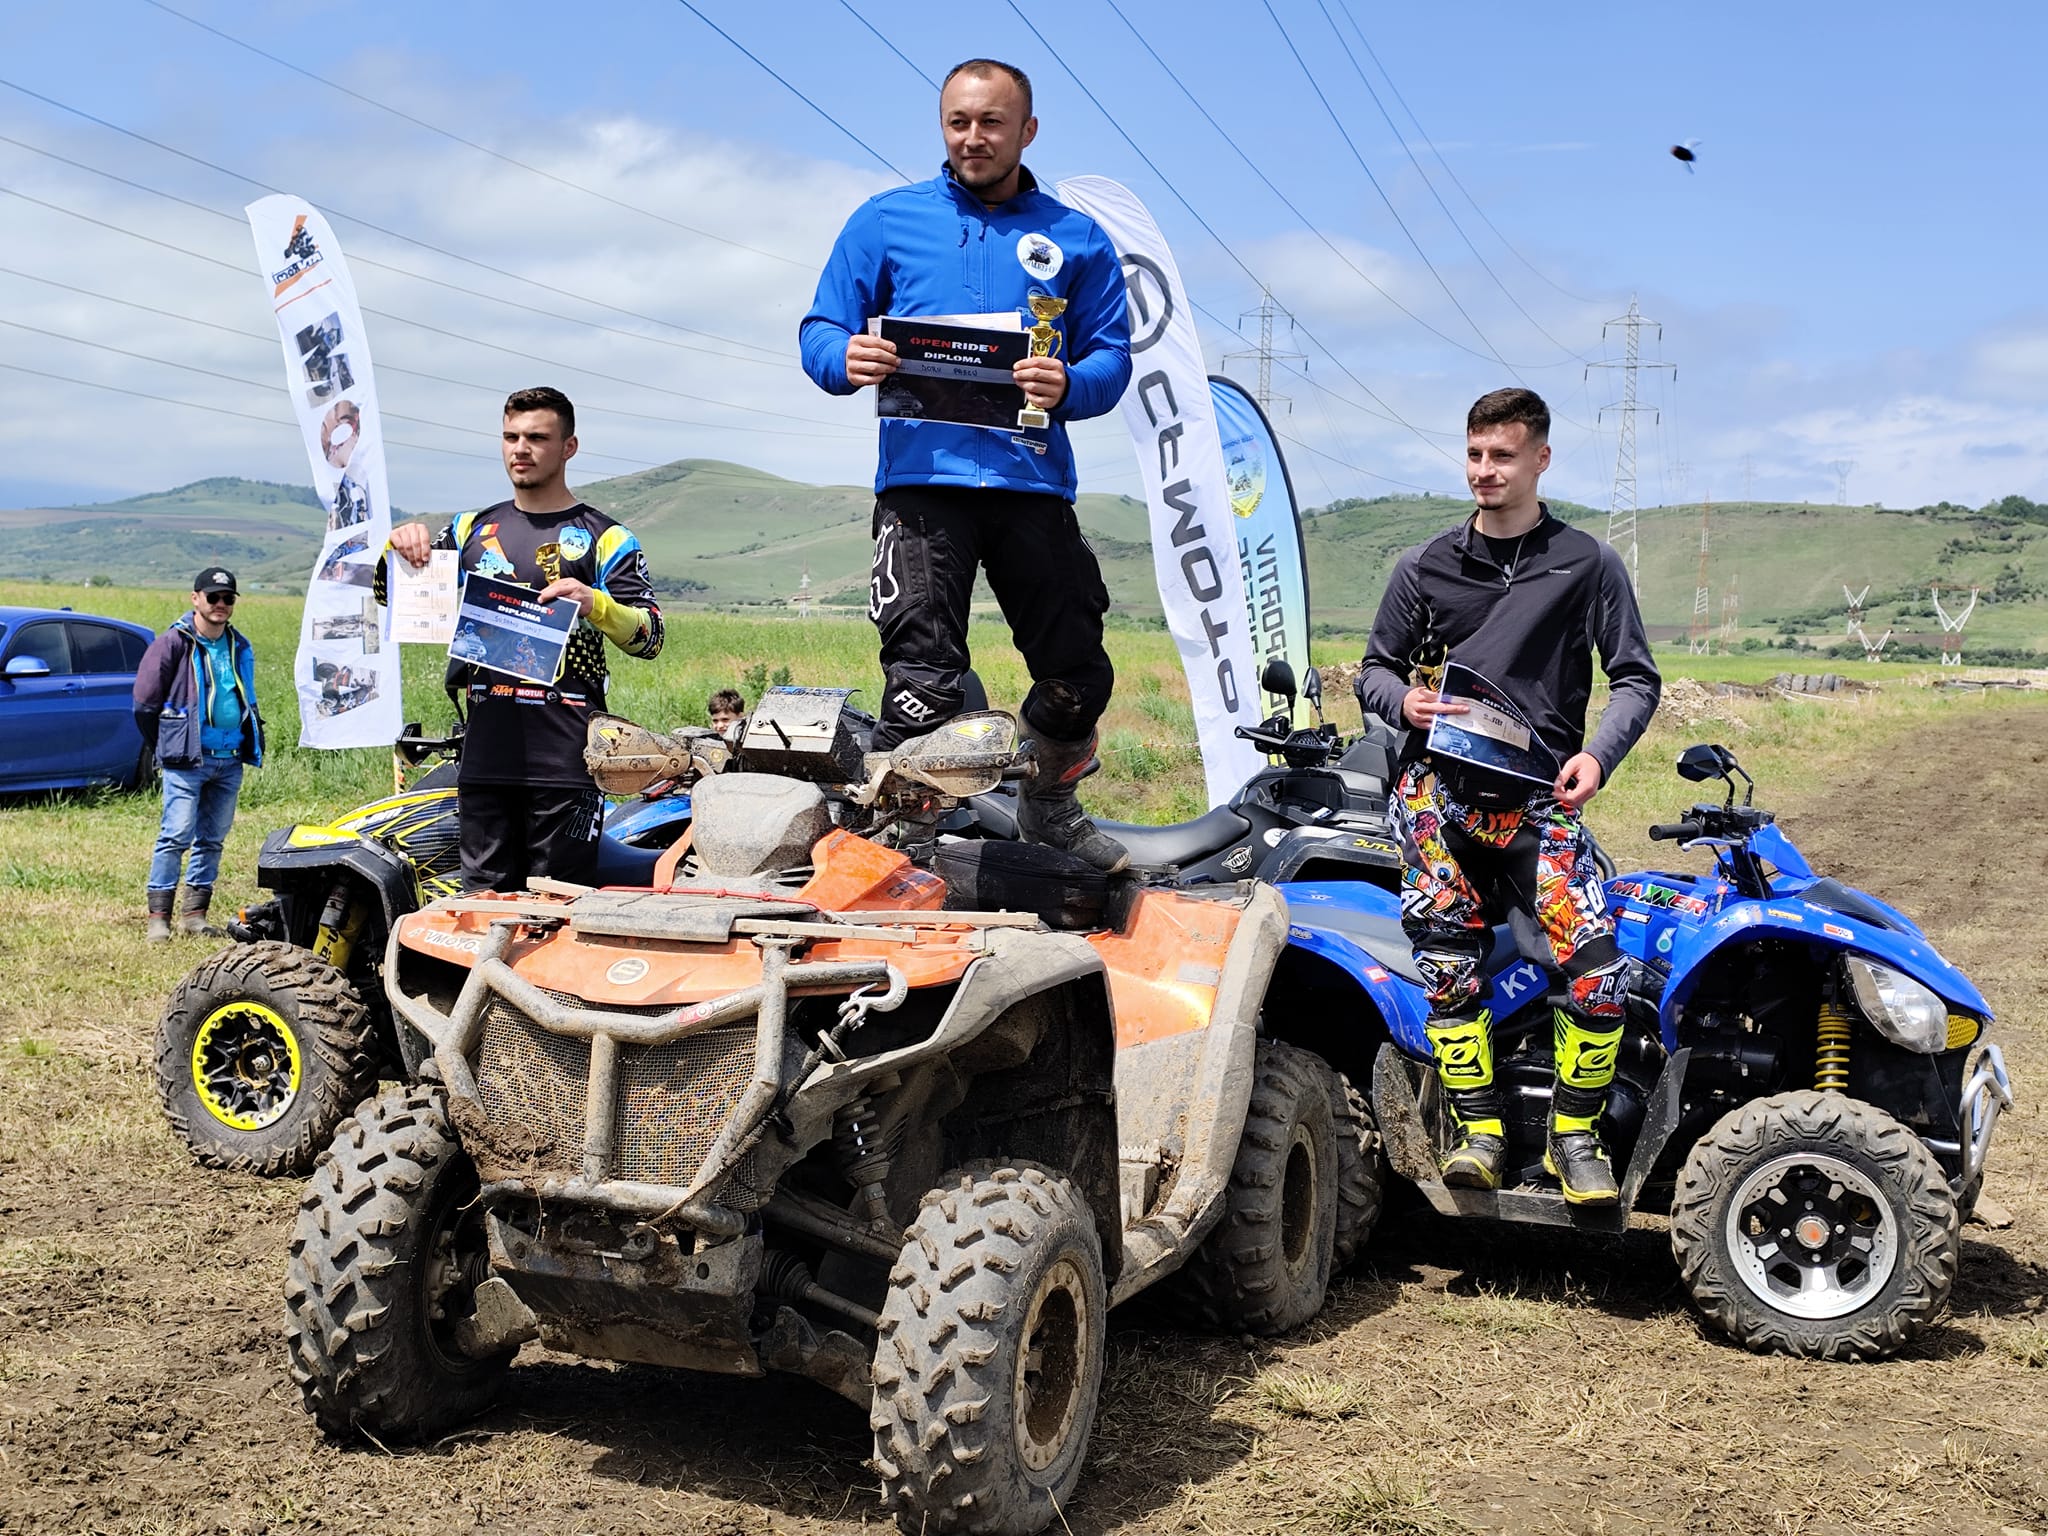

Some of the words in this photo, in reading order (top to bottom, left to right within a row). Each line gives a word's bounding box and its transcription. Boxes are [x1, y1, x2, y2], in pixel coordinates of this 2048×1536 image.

[923, 352, 983, 365] DIPLOMA
[497, 605, 542, 623] DIPLOMA
[517, 689, 544, 698] MOTUL
[893, 689, 936, 723] FOX
[1353, 838, 1398, 854] OUTL
[1608, 881, 1708, 917] MAXXER
